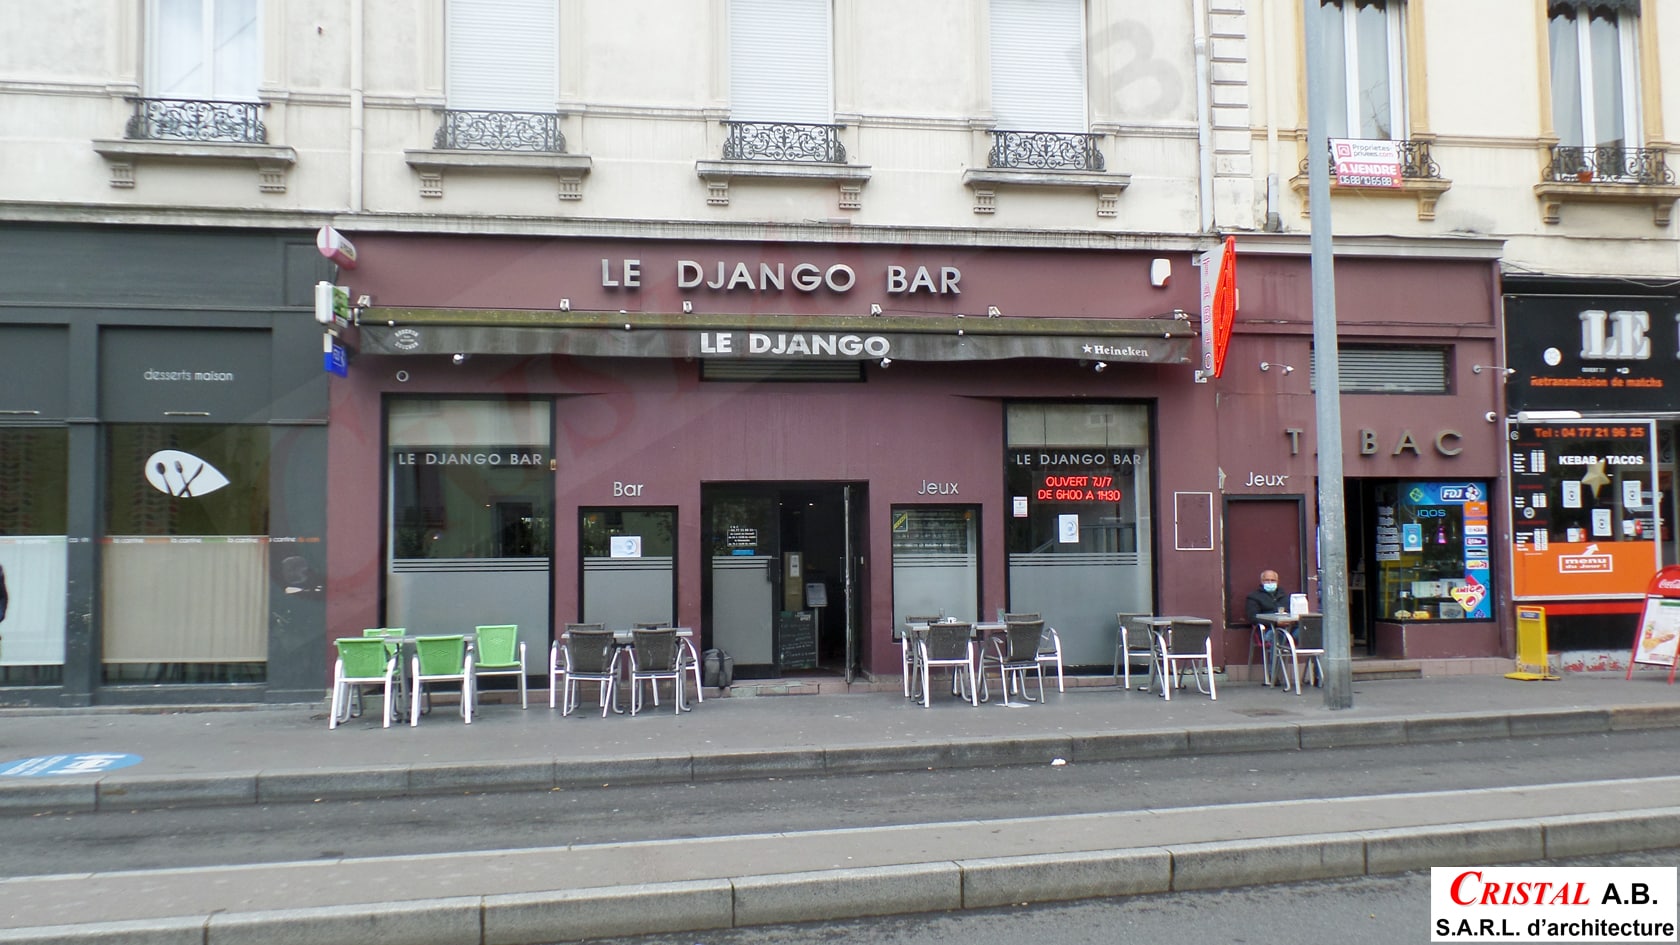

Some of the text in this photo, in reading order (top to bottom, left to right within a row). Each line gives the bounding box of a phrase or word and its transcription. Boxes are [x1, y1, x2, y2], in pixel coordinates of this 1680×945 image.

[1340, 163, 1397, 176] A VENDRE
[601, 259, 962, 294] LE DJANGO BAR
[1579, 310, 1651, 360] LE
[700, 332, 891, 356] LE DJANGO
[1094, 345, 1149, 357] Heineken
[143, 367, 234, 381] desserts maison
[1530, 375, 1663, 388] Retransmission de matchs
[1534, 427, 1553, 438] Tel
[1561, 427, 1576, 438] 04
[1578, 427, 1592, 438] 77
[1594, 427, 1610, 438] 21
[1612, 427, 1627, 438] 96
[1629, 427, 1646, 438] 25
[1286, 428, 1464, 457] TBAC
[398, 453, 543, 465] LE DJANGO BAR
[1016, 454, 1142, 465] LE DJANGO BAR
[1559, 455, 1598, 465] KEBAB
[1605, 455, 1644, 465] TACOS
[1045, 476, 1112, 487] OUVERT 7J/7
[1245, 471, 1285, 487] Jeux
[613, 481, 644, 497] Bar
[917, 479, 959, 495] Jeux
[1037, 489, 1121, 501] DE 6H00 A 1H30
[1442, 489, 1463, 499] FDJ
[1417, 508, 1446, 518] IQOS
